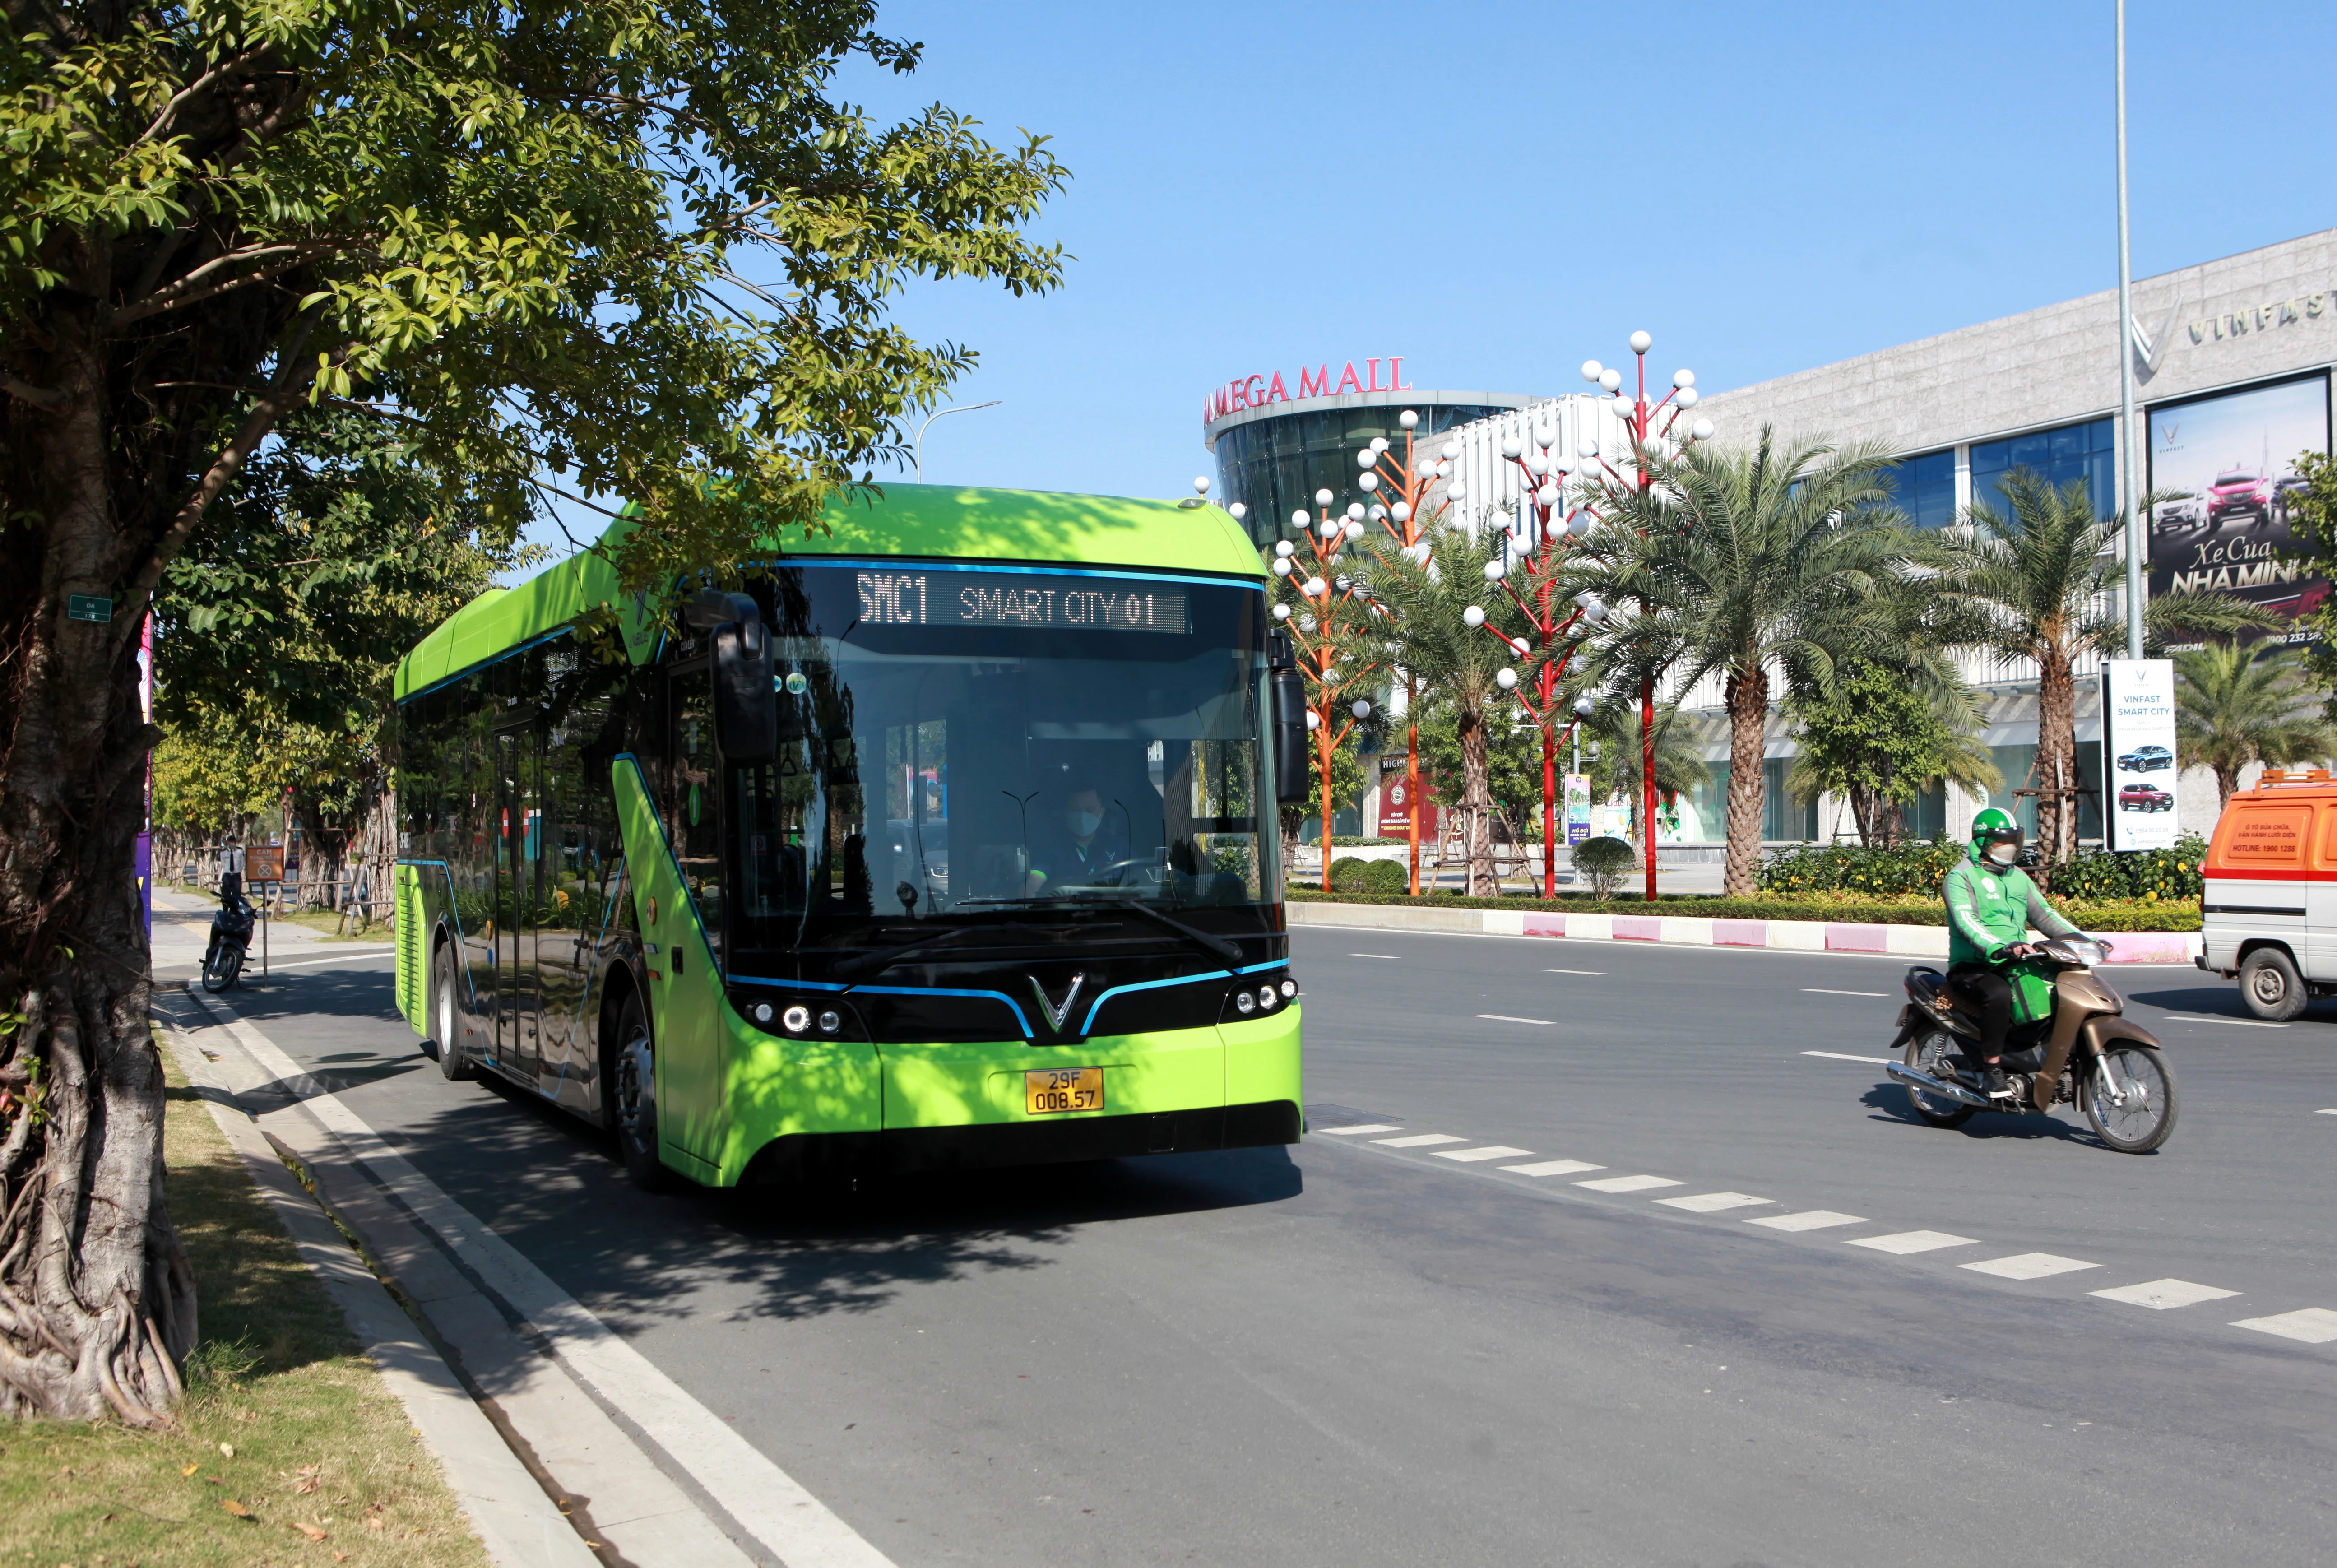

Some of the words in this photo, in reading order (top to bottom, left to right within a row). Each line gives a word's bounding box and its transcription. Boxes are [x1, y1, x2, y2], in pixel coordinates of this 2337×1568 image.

[2189, 285, 2337, 341] VINFAS
[1215, 370, 1291, 420] MEGA
[1297, 357, 1413, 399] MALL
[2189, 539, 2224, 569] Xe
[2171, 561, 2233, 595] NHÀ
[2235, 556, 2315, 587] MINH
[858, 573, 926, 624] SMC1
[960, 587, 1055, 622] SMART
[1065, 591, 1116, 623] CITY
[1125, 593, 1154, 625] 01
[2267, 634, 2287, 644] 1900
[2288, 632, 2306, 643] 232
[1974, 822, 1988, 830] Grab
[1048, 1071, 1080, 1090] 29F
[1036, 1090, 1095, 1110] 008.57
